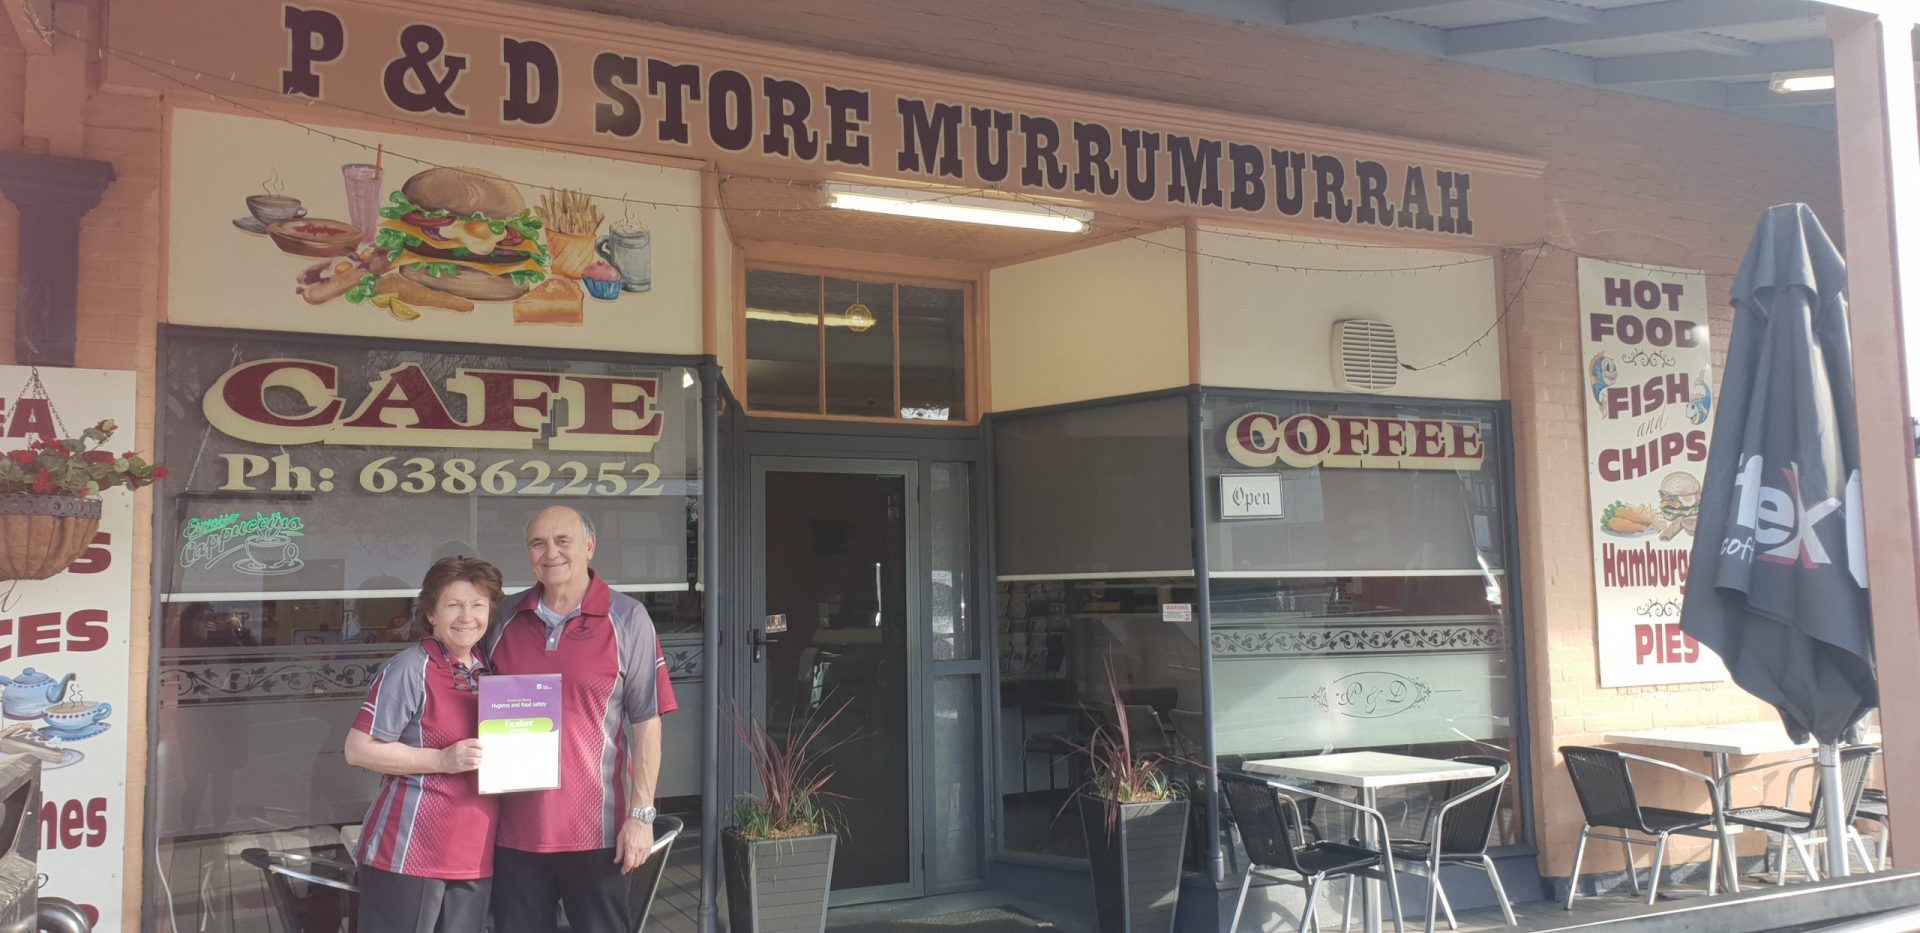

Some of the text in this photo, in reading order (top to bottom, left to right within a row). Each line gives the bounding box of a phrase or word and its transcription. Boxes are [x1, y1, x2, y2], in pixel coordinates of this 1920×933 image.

[282, 5, 1474, 236] P & D STORE MURRUMBURRAH
[1604, 277, 1684, 312] HOT
[1589, 313, 1700, 349] FOOD
[0, 397, 57, 438] A
[203, 357, 665, 452] CAFE
[1607, 372, 1690, 420] FISH
[1225, 411, 1484, 470] COFFEE
[1636, 404, 1668, 438] and
[218, 453, 665, 496] Ph: 63862252
[1598, 431, 1708, 482] CHIPS
[1231, 486, 1271, 513] Open
[180, 512, 304, 568] Cappuccino
[1602, 541, 1690, 595] Hamburg
[1635, 623, 1699, 665] PIES
[532, 701, 547, 709] safety
